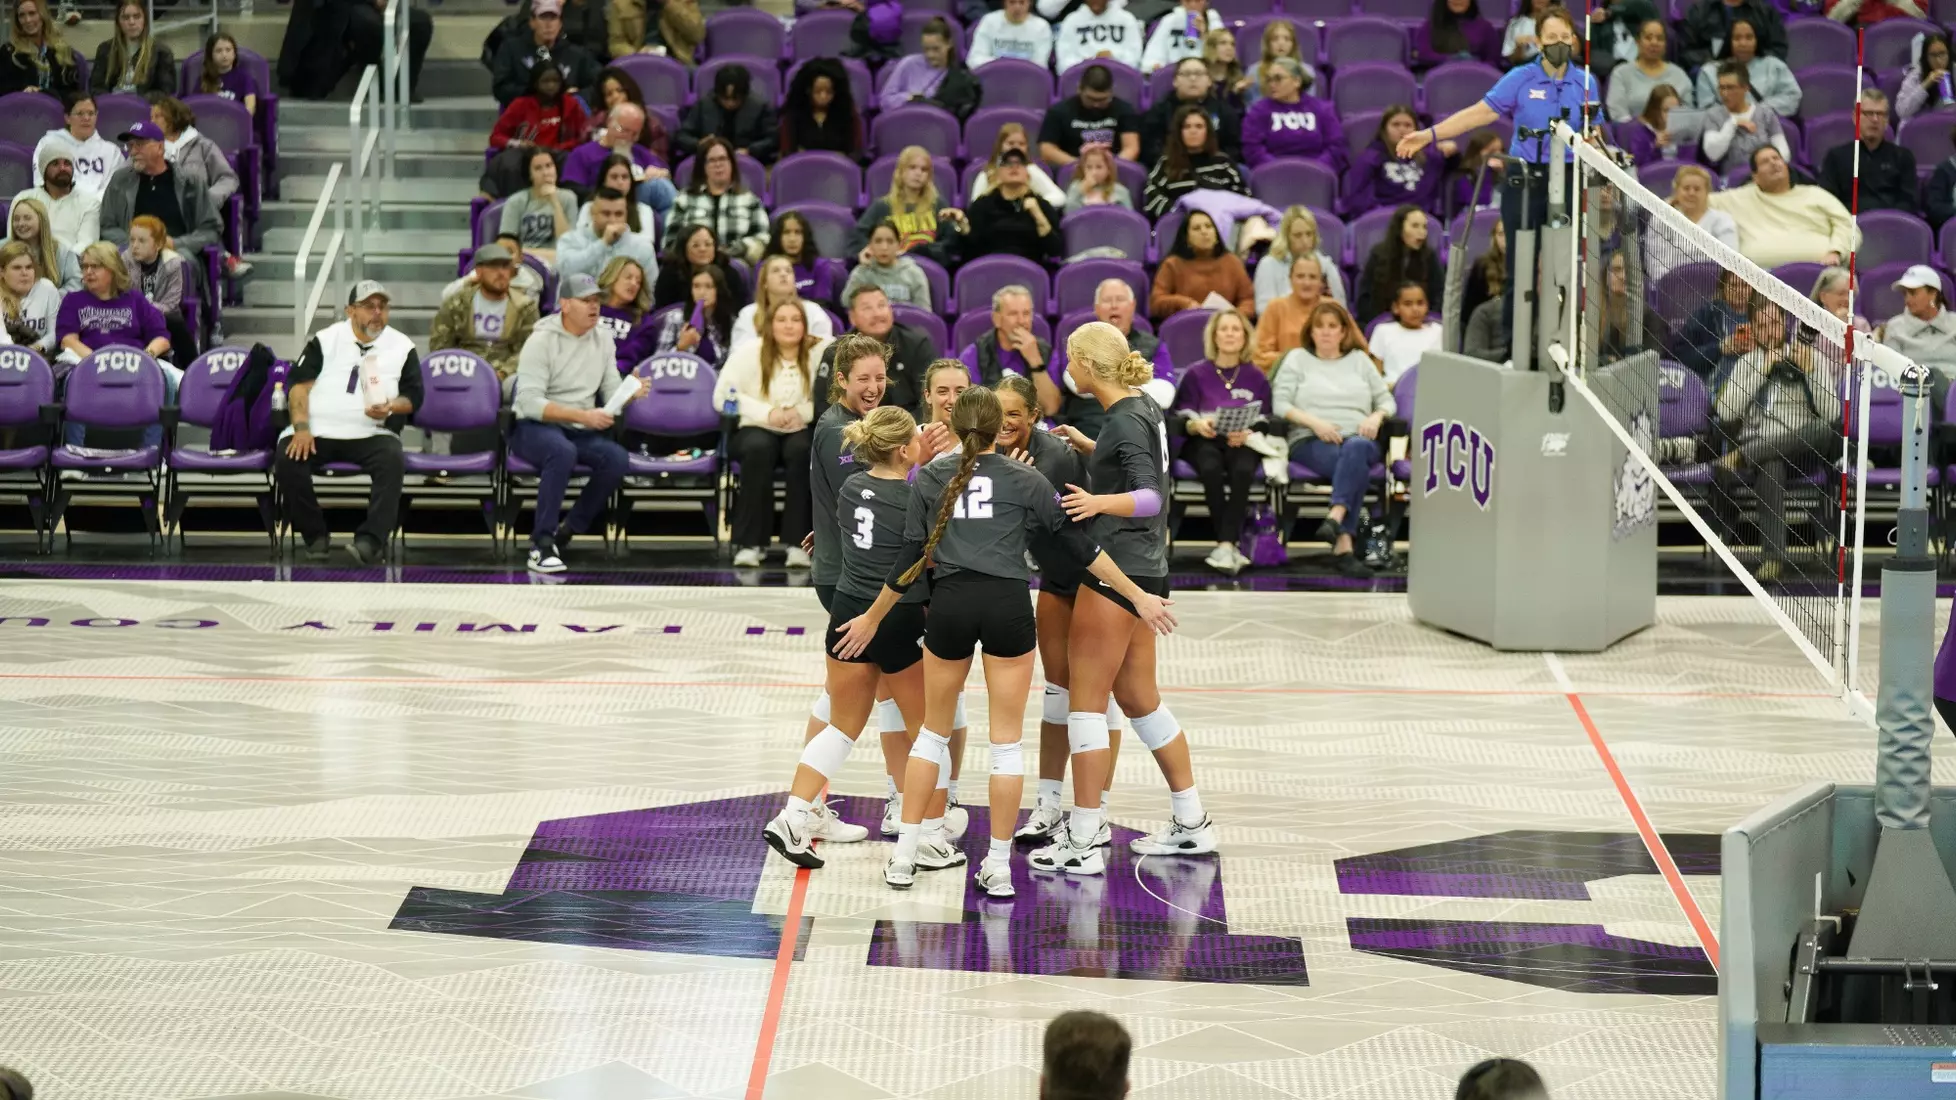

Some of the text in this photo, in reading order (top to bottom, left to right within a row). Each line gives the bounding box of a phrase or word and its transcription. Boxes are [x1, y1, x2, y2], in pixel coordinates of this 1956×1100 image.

[1076, 25, 1125, 44] TCU
[0, 350, 31, 372] CU
[94, 351, 142, 374] TCU
[428, 355, 478, 378] TCU
[651, 357, 698, 380] TCU
[1420, 418, 1495, 512] TCU
[852, 506, 875, 550] 3
[0, 616, 219, 629] COU
[280, 620, 682, 634] FAMILY
